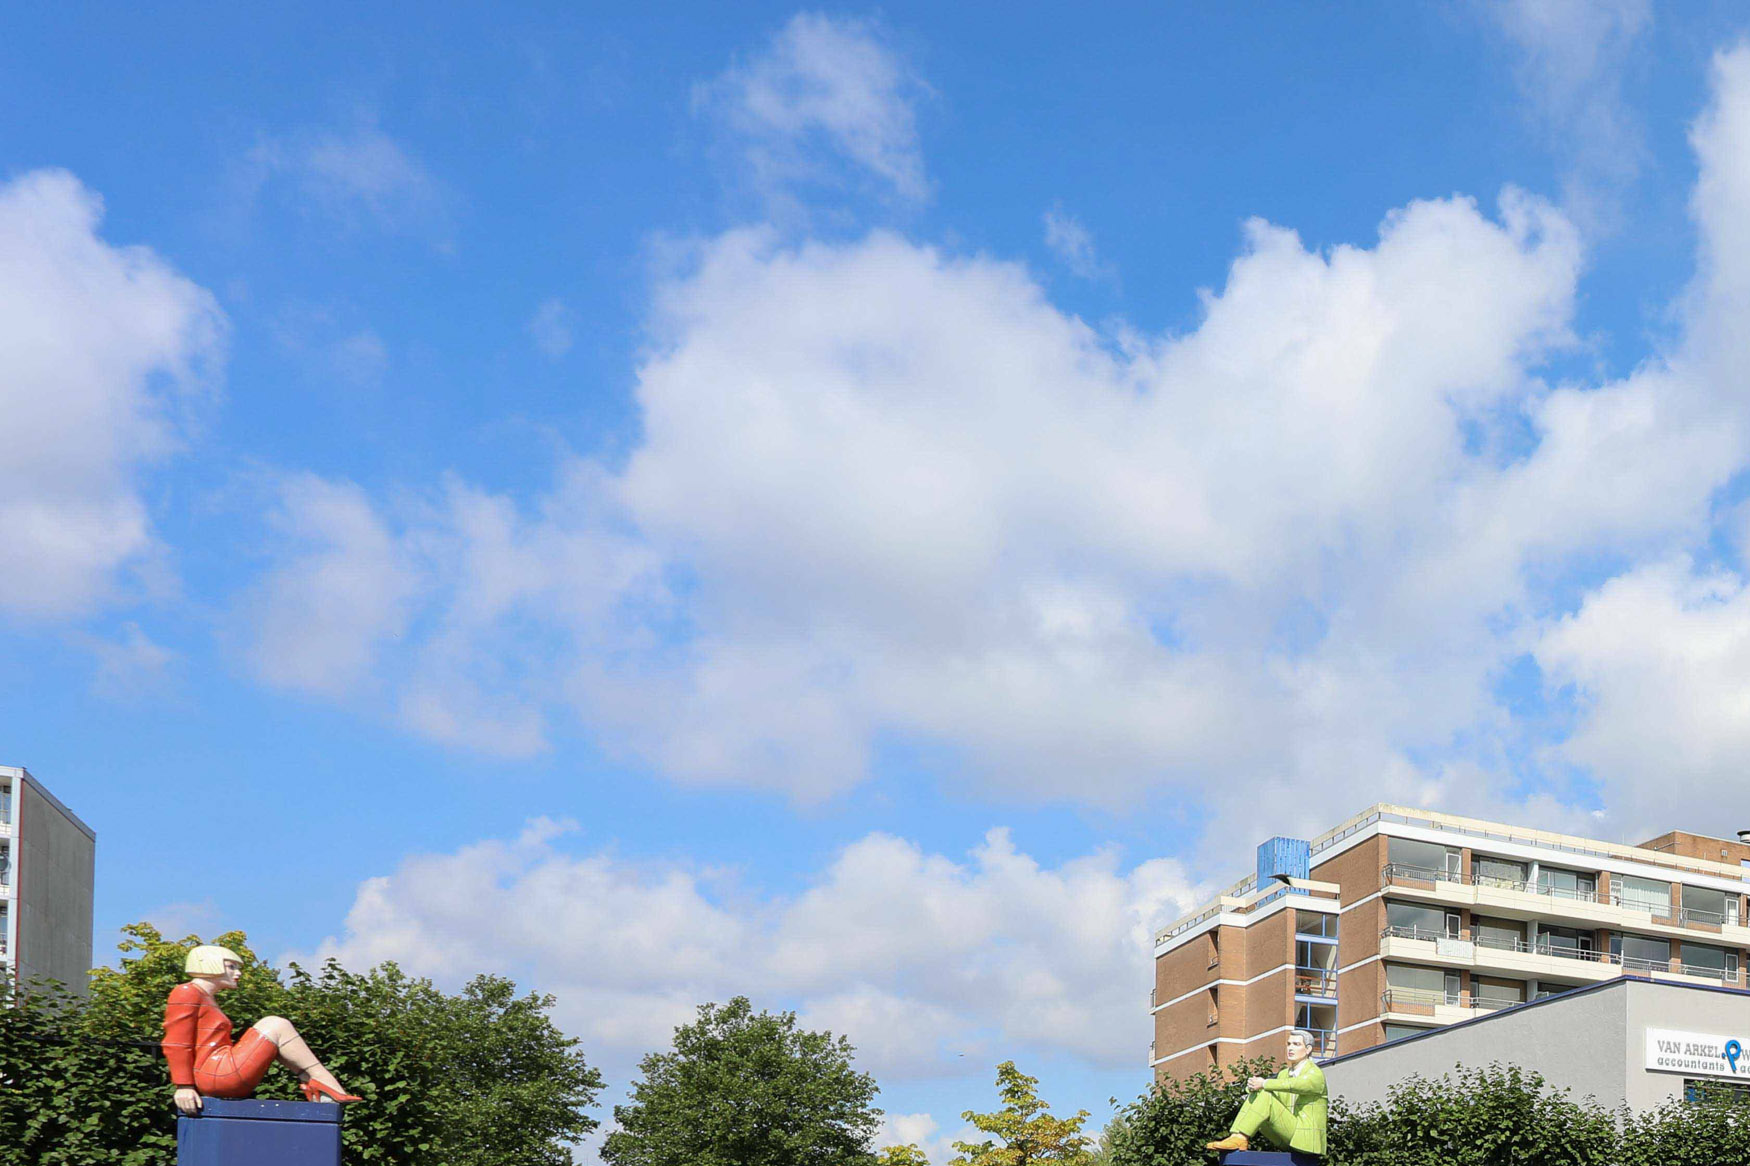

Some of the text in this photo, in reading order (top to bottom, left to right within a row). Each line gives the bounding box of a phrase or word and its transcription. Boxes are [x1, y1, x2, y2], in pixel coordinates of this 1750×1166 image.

[1657, 1040, 1721, 1059] VAN ARKEL
[1657, 1056, 1725, 1072] accountants
